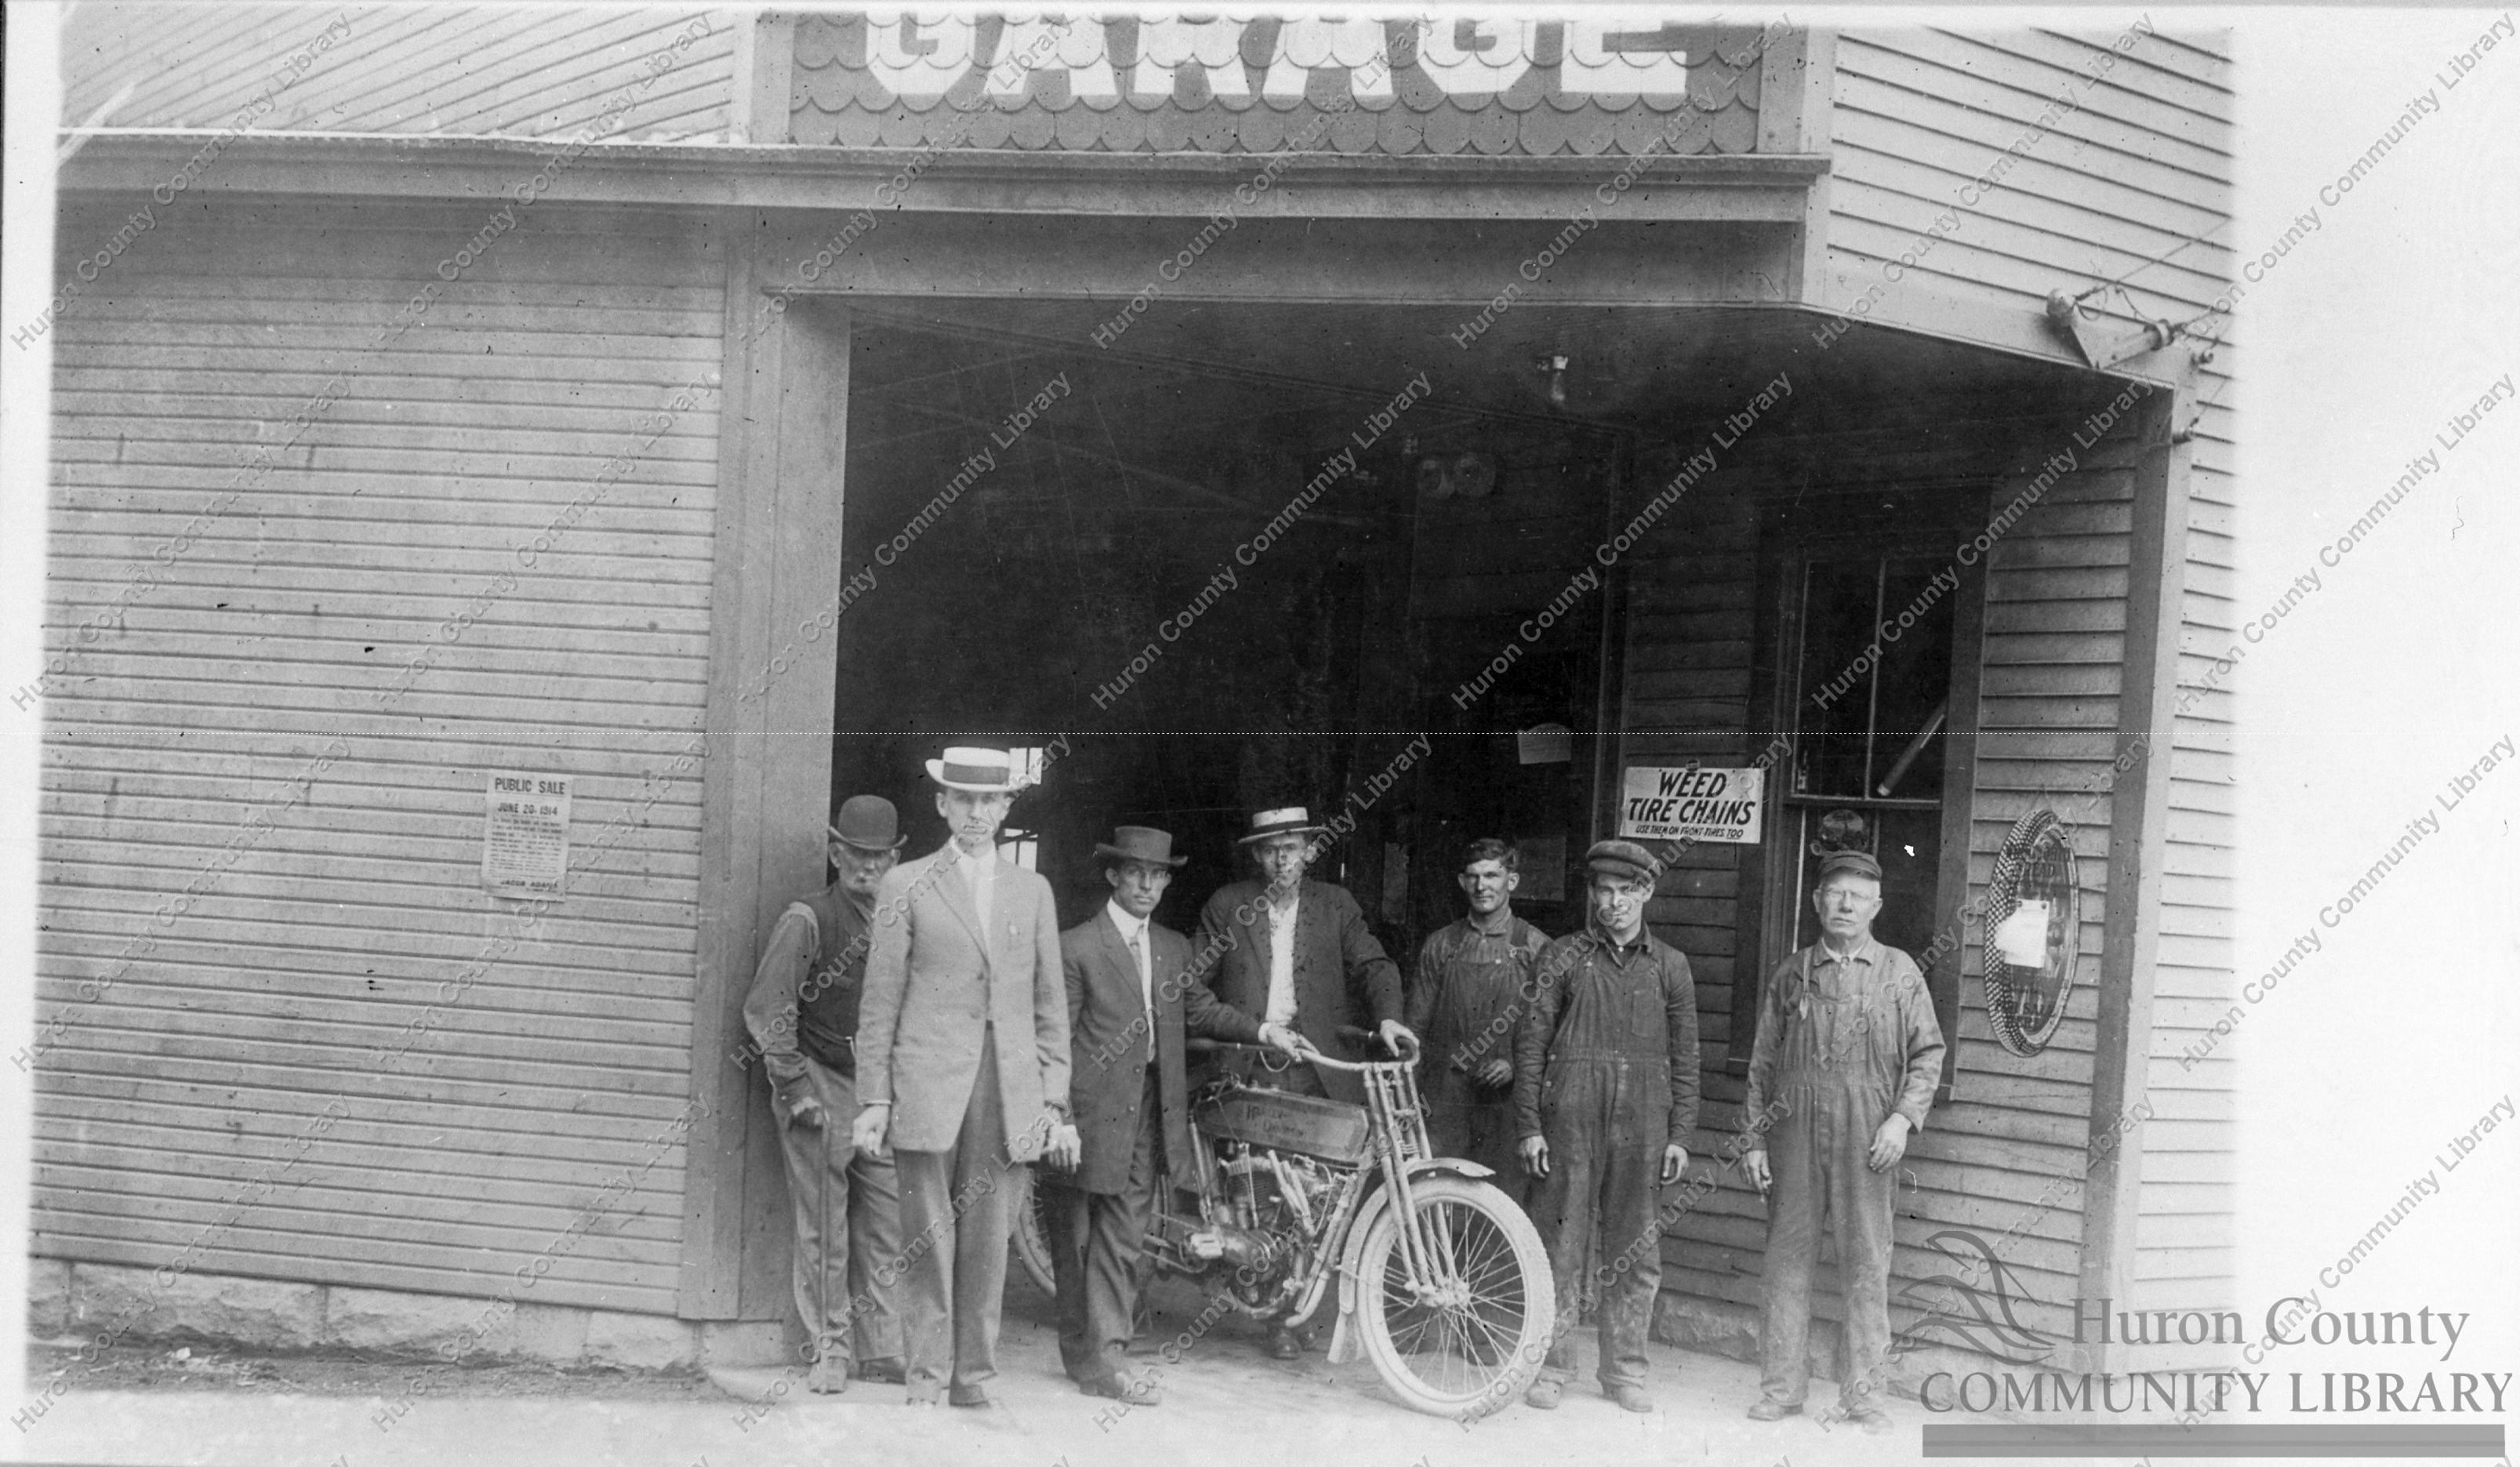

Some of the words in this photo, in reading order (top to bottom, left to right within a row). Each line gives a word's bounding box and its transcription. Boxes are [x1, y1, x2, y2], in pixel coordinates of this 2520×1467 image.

[865, 11, 1687, 96] GARAGE
[495, 777, 532, 793] PUBLIC
[539, 780, 565, 795] SALE
[1659, 772, 1727, 797] WEED
[497, 802, 518, 813] JUNE
[539, 806, 558, 815] 1914
[1629, 797, 1679, 822] TIRE
[1678, 799, 1756, 826] CHAINS
[1636, 825, 1650, 834] USE
[1650, 826, 1669, 835] THEM
[1669, 826, 1679, 836] ON
[1705, 828, 1726, 838] TIRES
[1726, 830, 1744, 839] TOO
